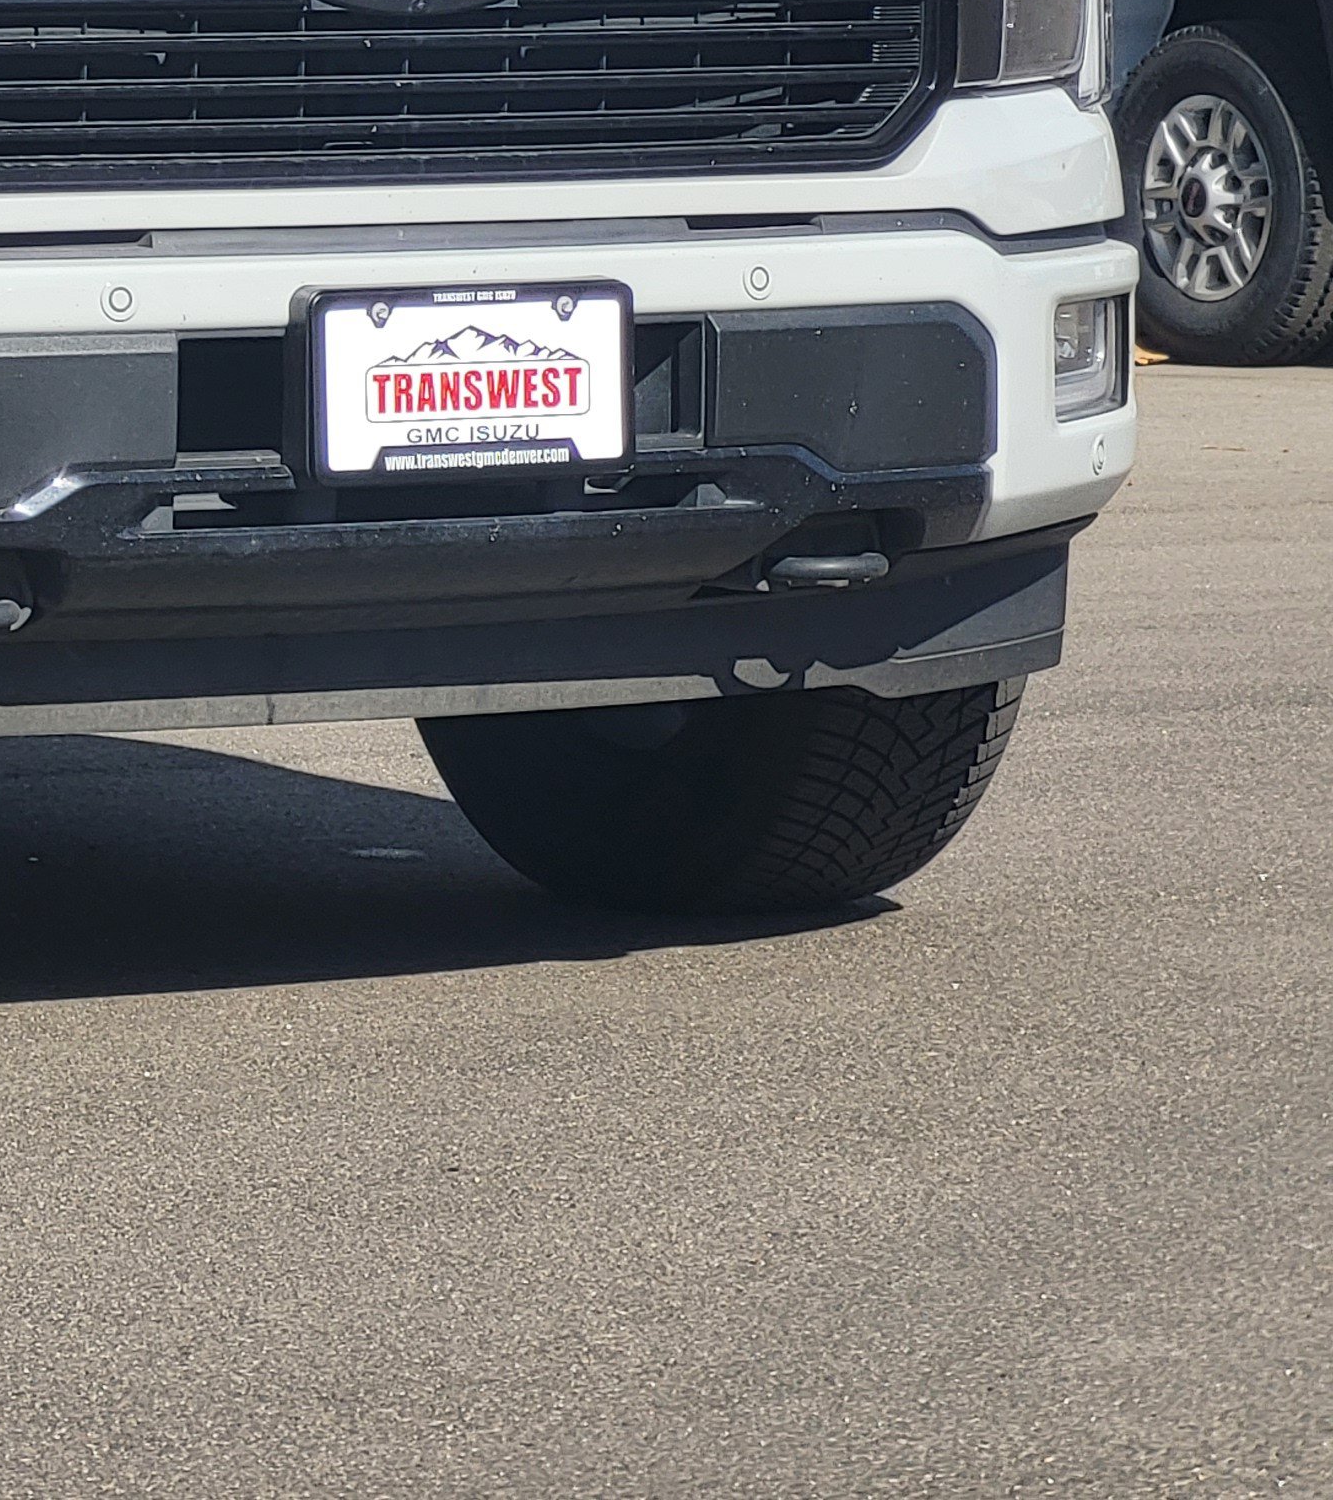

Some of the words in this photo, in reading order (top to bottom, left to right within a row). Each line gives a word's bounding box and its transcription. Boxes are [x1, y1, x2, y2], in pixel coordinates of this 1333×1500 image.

[373, 367, 582, 414] TRANSWEST
[406, 426, 460, 444] GMC
[470, 423, 540, 442] ISUZU
[384, 447, 570, 472] www.transwestgmcdenver.com
